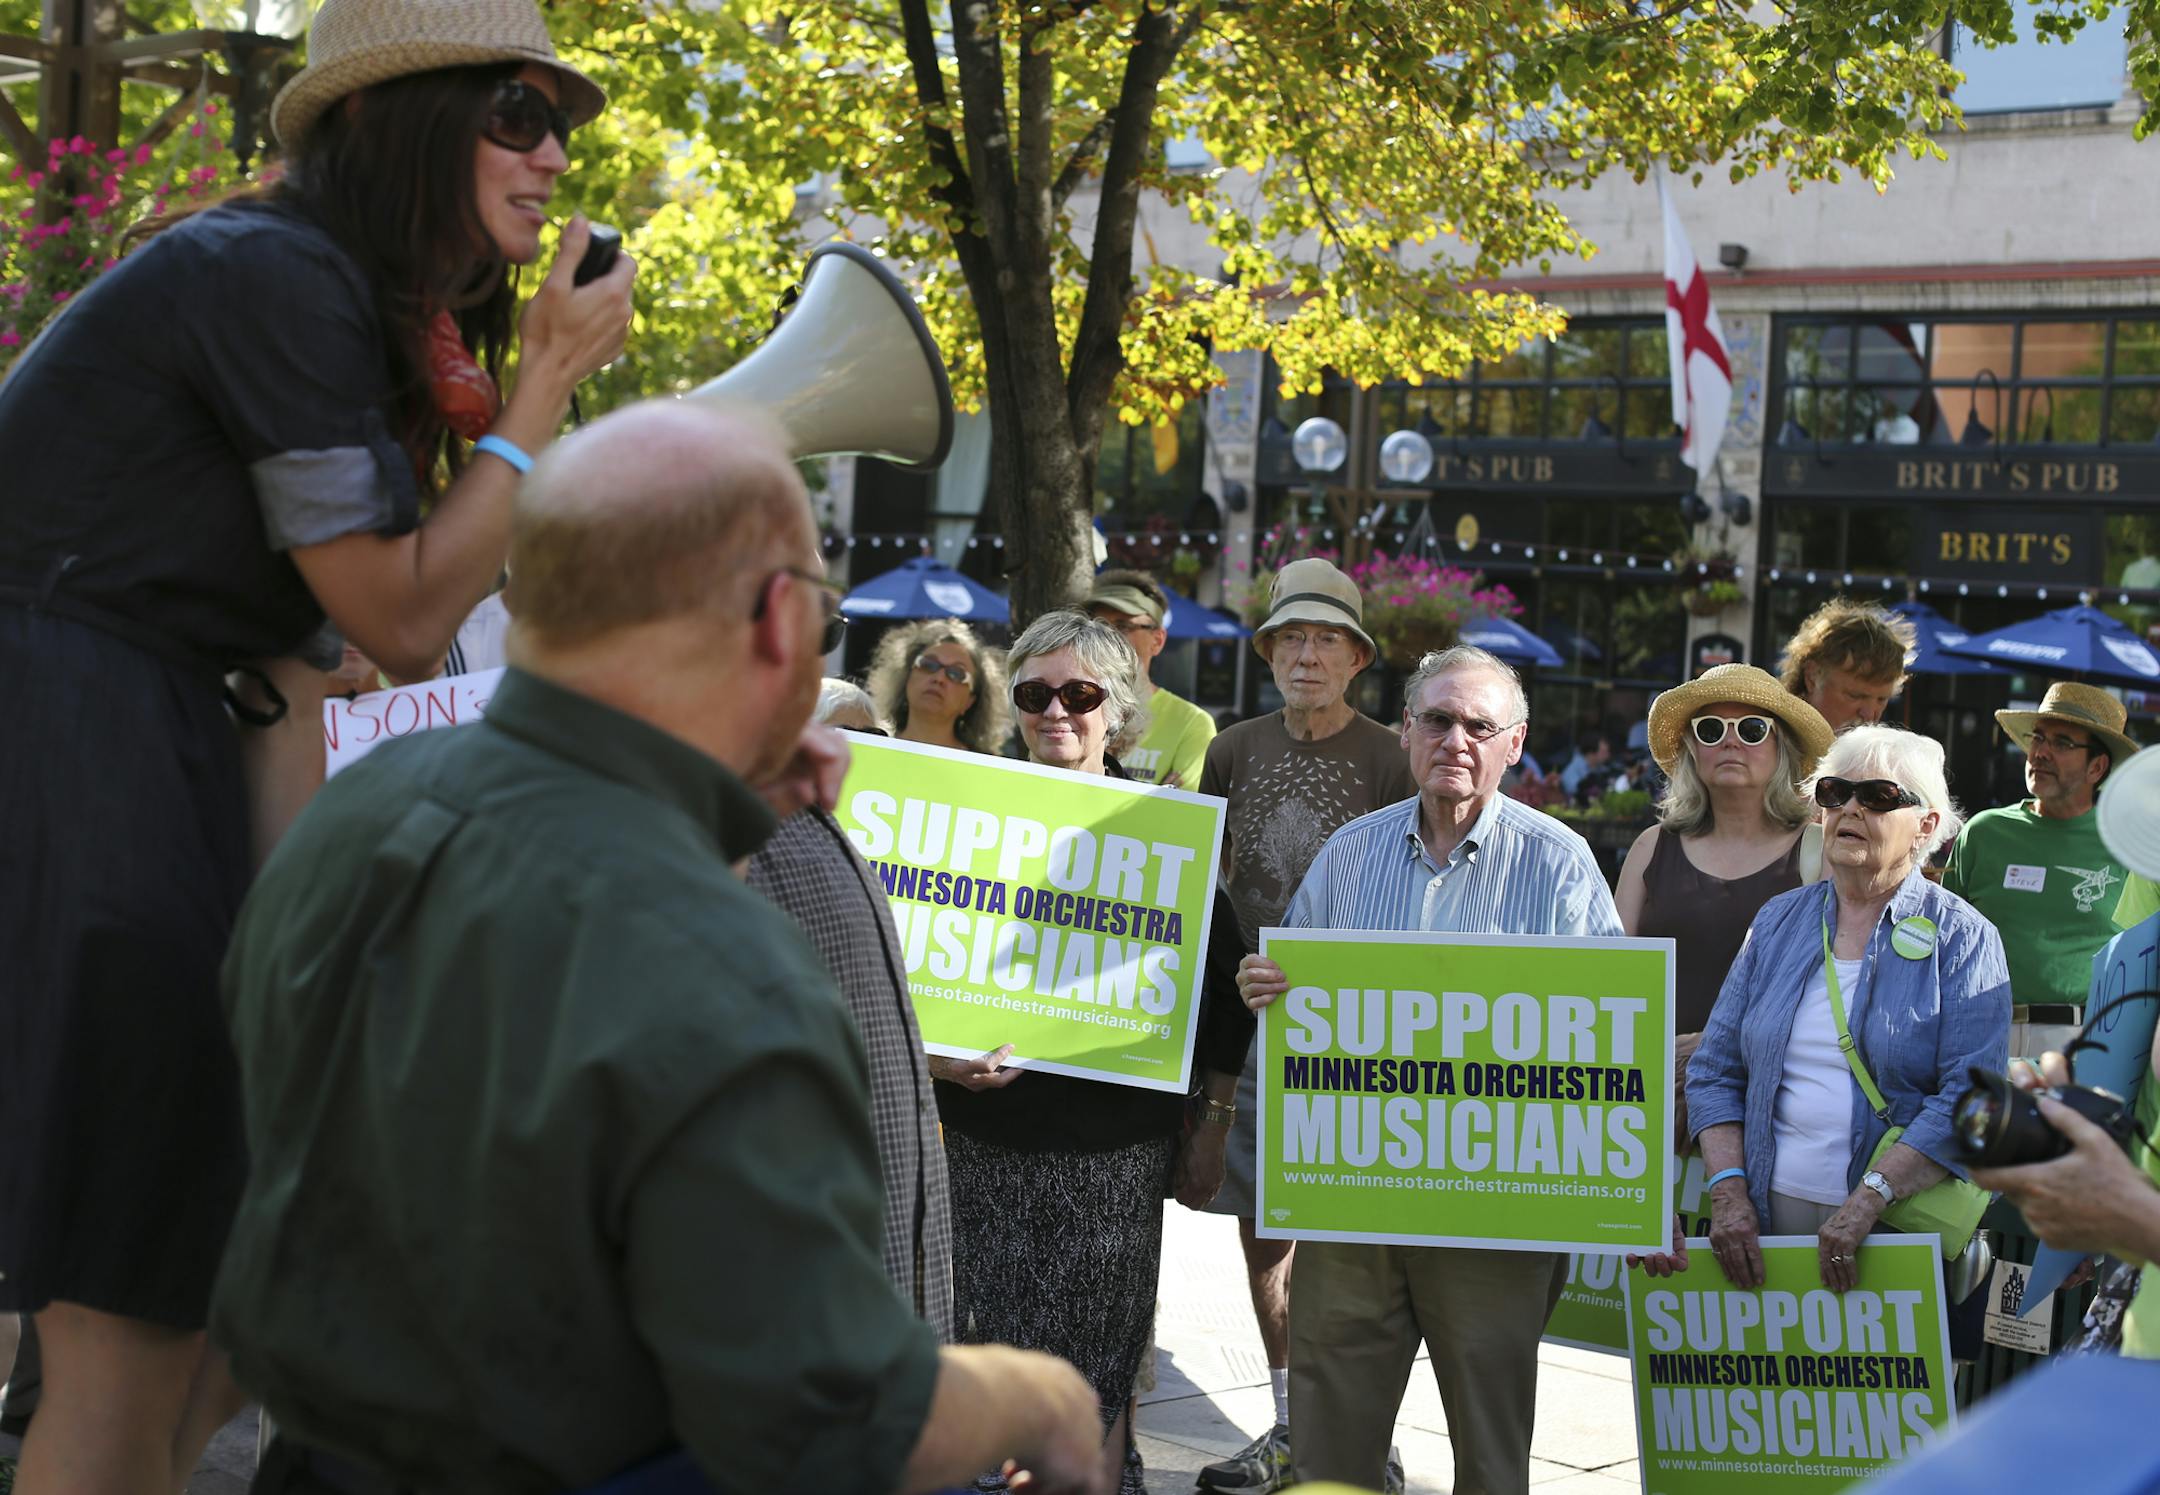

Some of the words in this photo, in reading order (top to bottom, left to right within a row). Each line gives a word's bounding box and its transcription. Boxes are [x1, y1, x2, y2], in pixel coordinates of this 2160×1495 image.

[1490, 456, 1554, 481] PUB
[1897, 461, 2030, 491] BRIT'S
[2040, 462, 2119, 492] PUB
[1940, 531, 2072, 565] BRIT'S
[847, 790, 1195, 907] SUPPORT
[865, 859, 1005, 915] NNESOTA
[1015, 886, 1182, 946] ORCHESTRA
[892, 900, 1181, 1015] USICIANS
[1284, 986, 1647, 1064] SUPPORT
[1283, 1056, 1456, 1095] MINNESOTA
[1463, 1062, 1646, 1102] ORCHESTRA
[1282, 1093, 1647, 1179] MUSICIANS
[1283, 1170, 1646, 1203] www.minnesotaorchestramusicians.org
[1645, 1289, 1923, 1353] SUPPORT
[1649, 1354, 1781, 1387] MINNESOTA
[1785, 1355, 1930, 1389] ORCHESTRA
[1651, 1388, 1938, 1460] MUSICIANS
